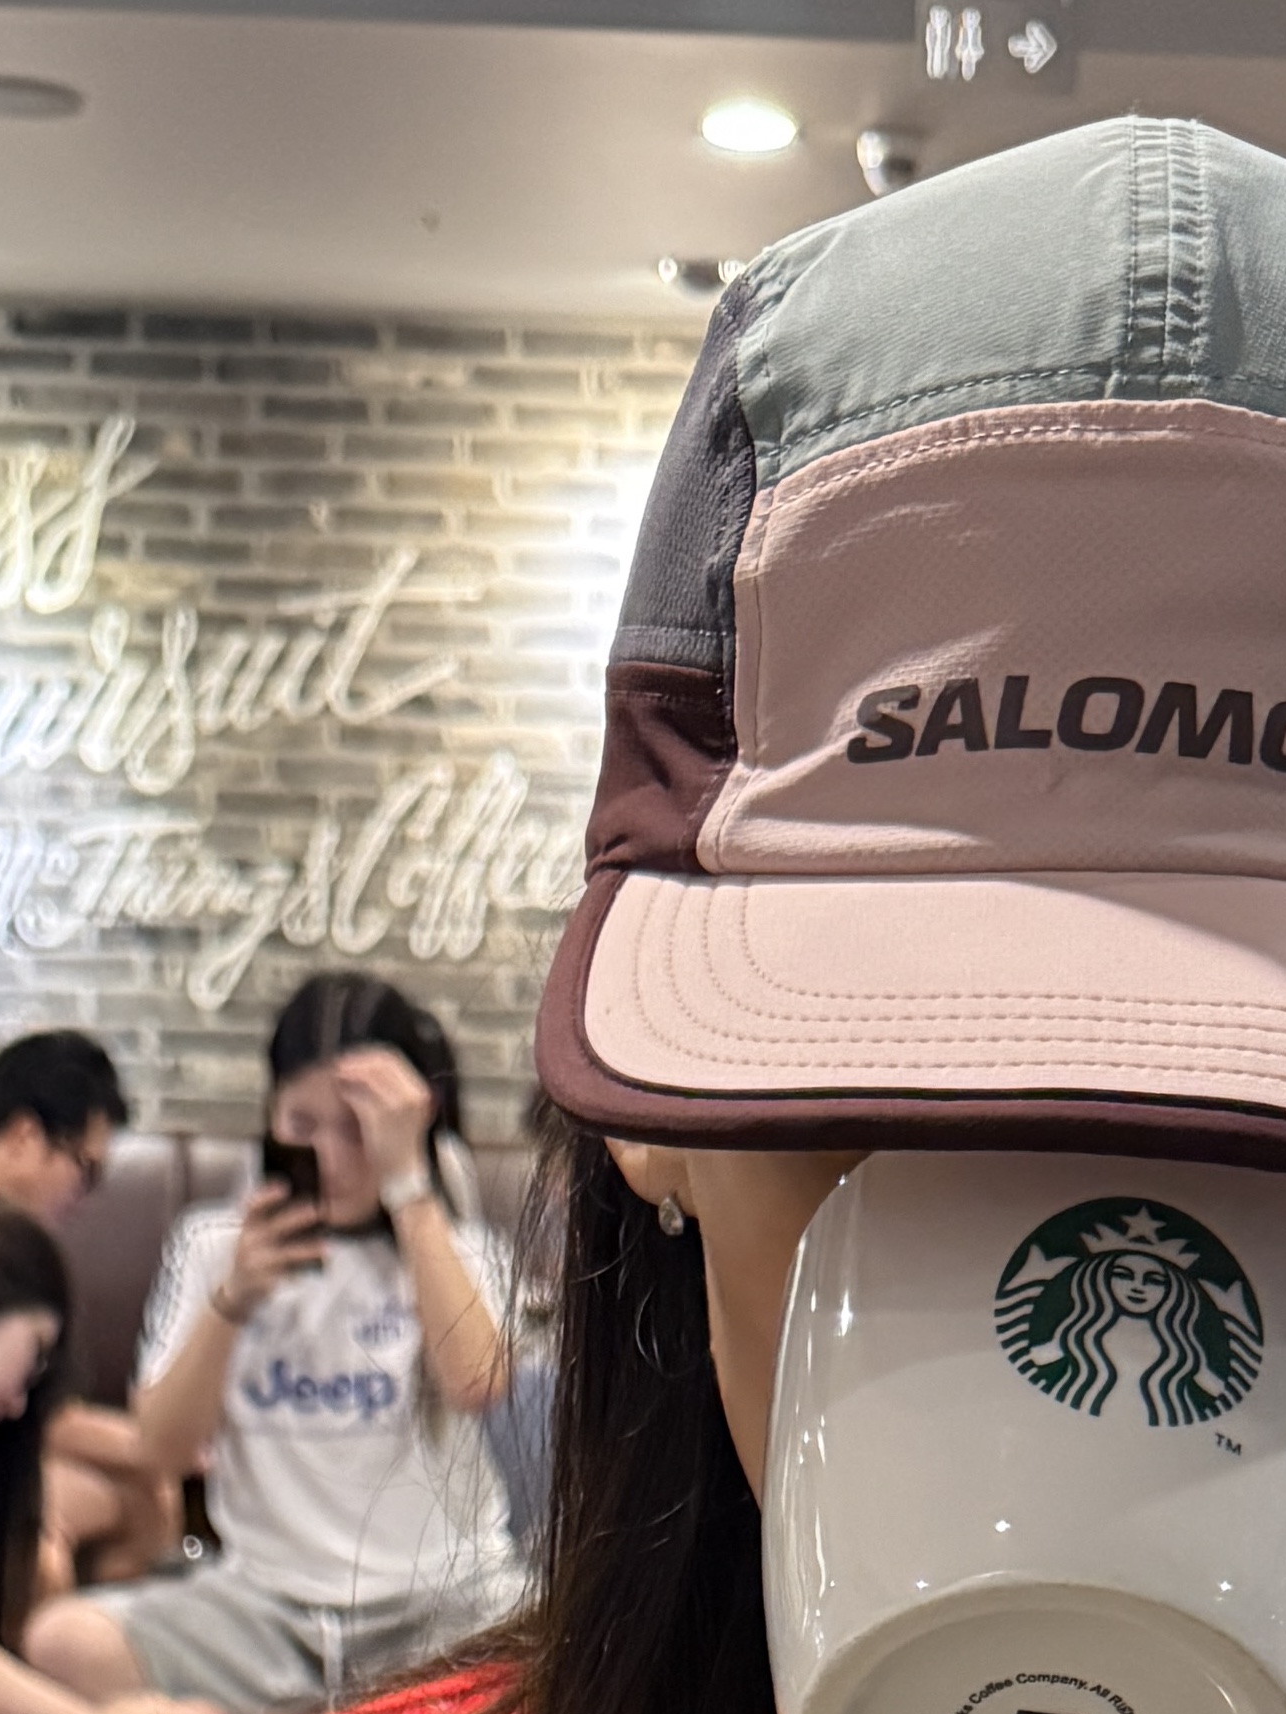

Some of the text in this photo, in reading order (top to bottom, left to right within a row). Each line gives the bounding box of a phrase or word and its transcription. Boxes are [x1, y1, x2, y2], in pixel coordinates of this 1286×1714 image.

[241, 1358, 398, 1422] Jeep
[968, 1678, 1013, 1704] Coffee
[1089, 1684, 1111, 1699] All
